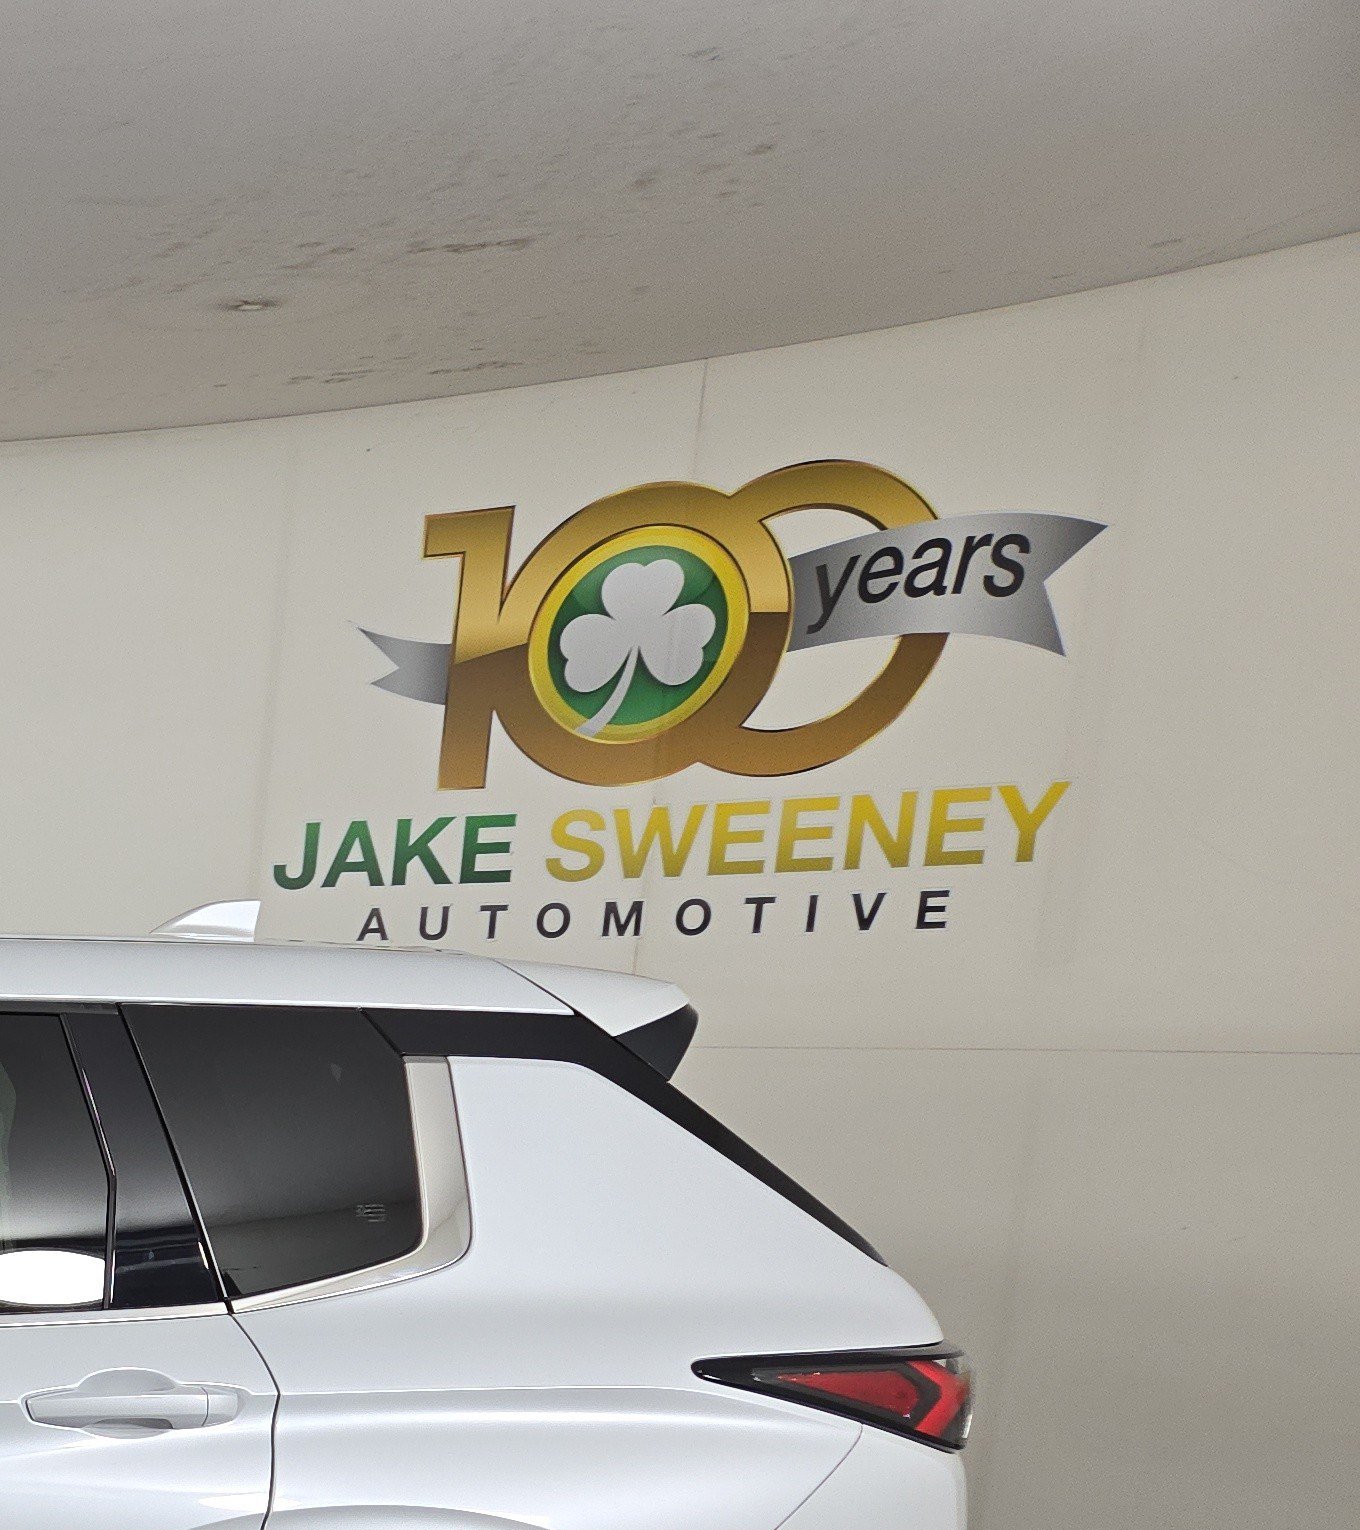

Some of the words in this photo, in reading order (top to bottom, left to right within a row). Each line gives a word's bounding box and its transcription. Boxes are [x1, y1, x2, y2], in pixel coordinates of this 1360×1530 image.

[806, 533, 1031, 633] years
[273, 813, 517, 890] JAKE
[545, 781, 1071, 881] SWEENEY
[357, 889, 951, 942] AUTOMOTIVE
